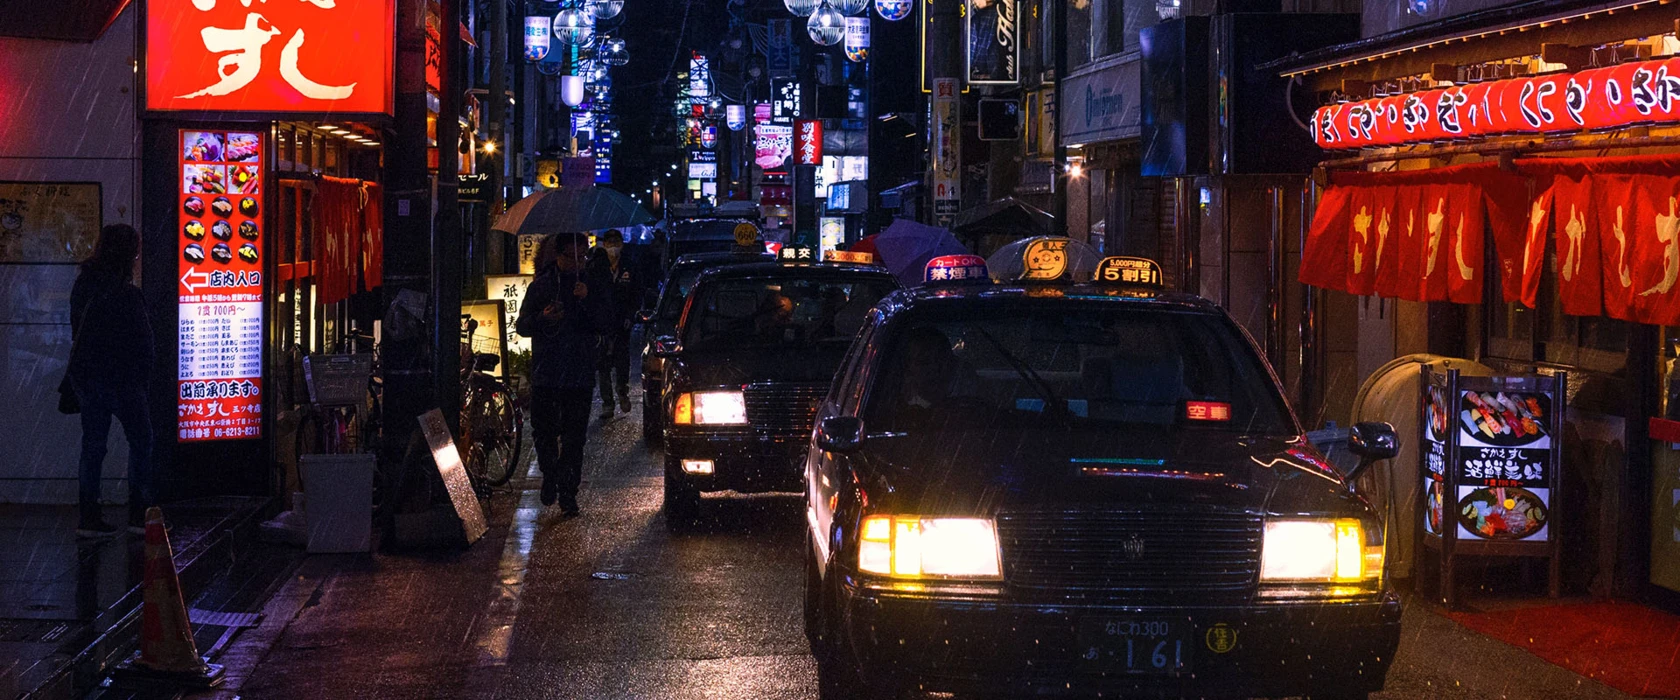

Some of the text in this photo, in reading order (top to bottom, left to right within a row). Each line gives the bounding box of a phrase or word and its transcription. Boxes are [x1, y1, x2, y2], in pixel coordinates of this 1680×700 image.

[173, 12, 357, 99] すし
[209, 269, 261, 287] 店内入口
[180, 380, 260, 399] 出前承ります。
